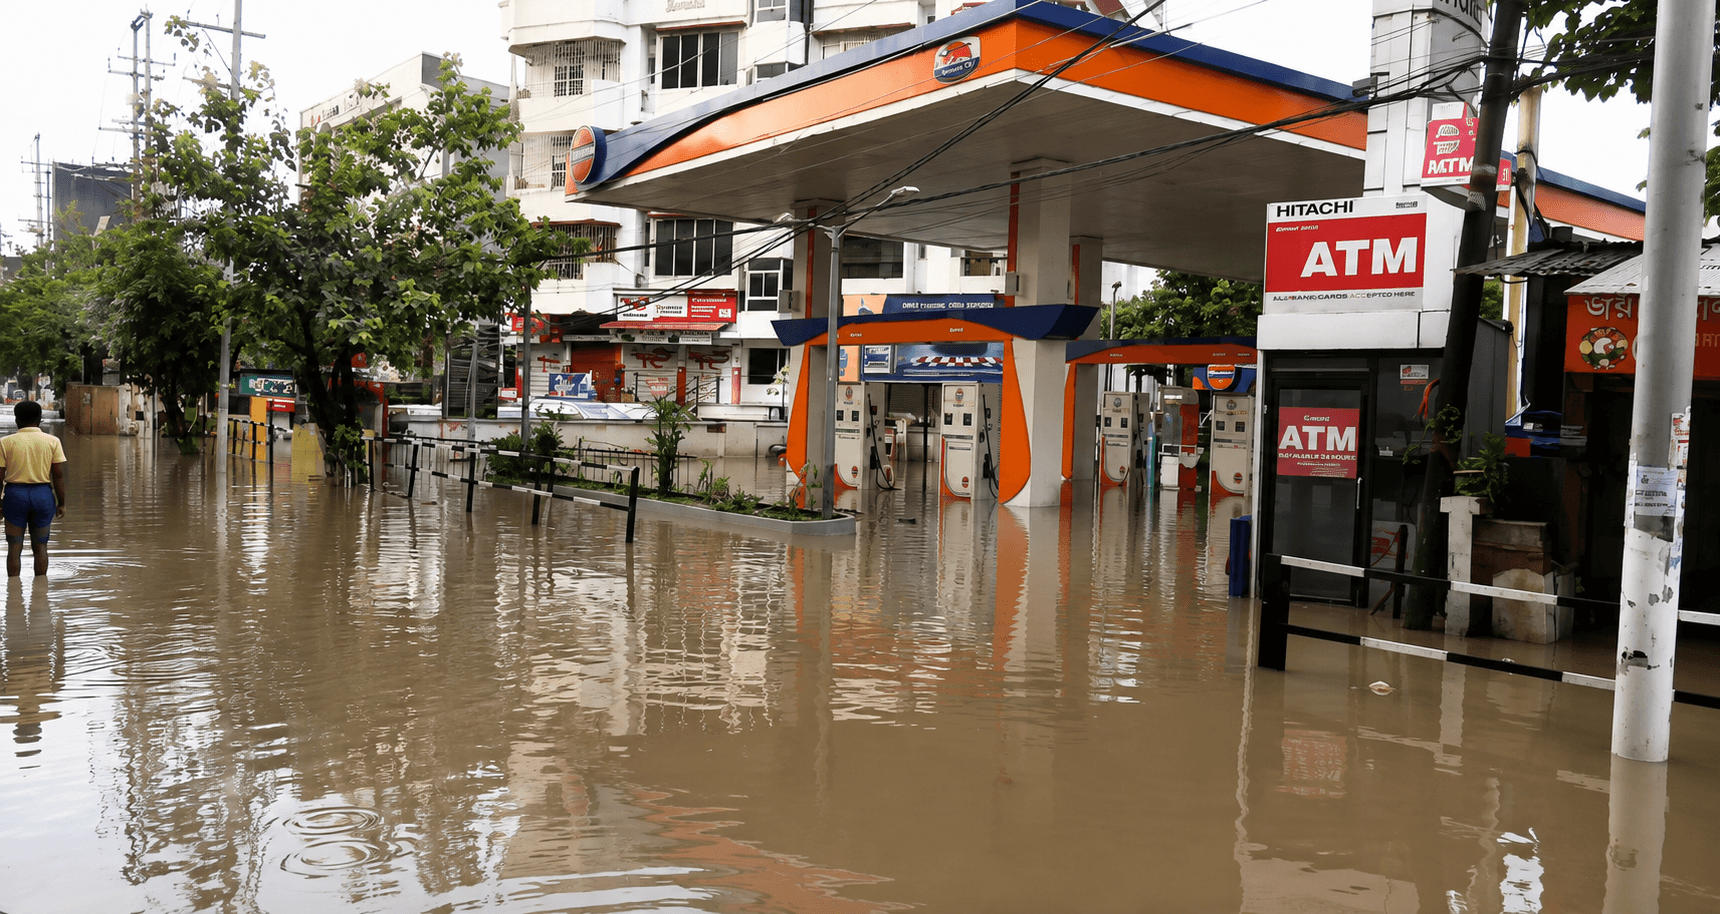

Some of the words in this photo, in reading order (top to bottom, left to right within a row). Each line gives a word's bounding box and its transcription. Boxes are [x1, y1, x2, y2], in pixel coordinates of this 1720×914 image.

[1276, 200, 1354, 217] HITACHI
[1300, 236, 1418, 278] ATM
[1279, 425, 1357, 452] ATM
